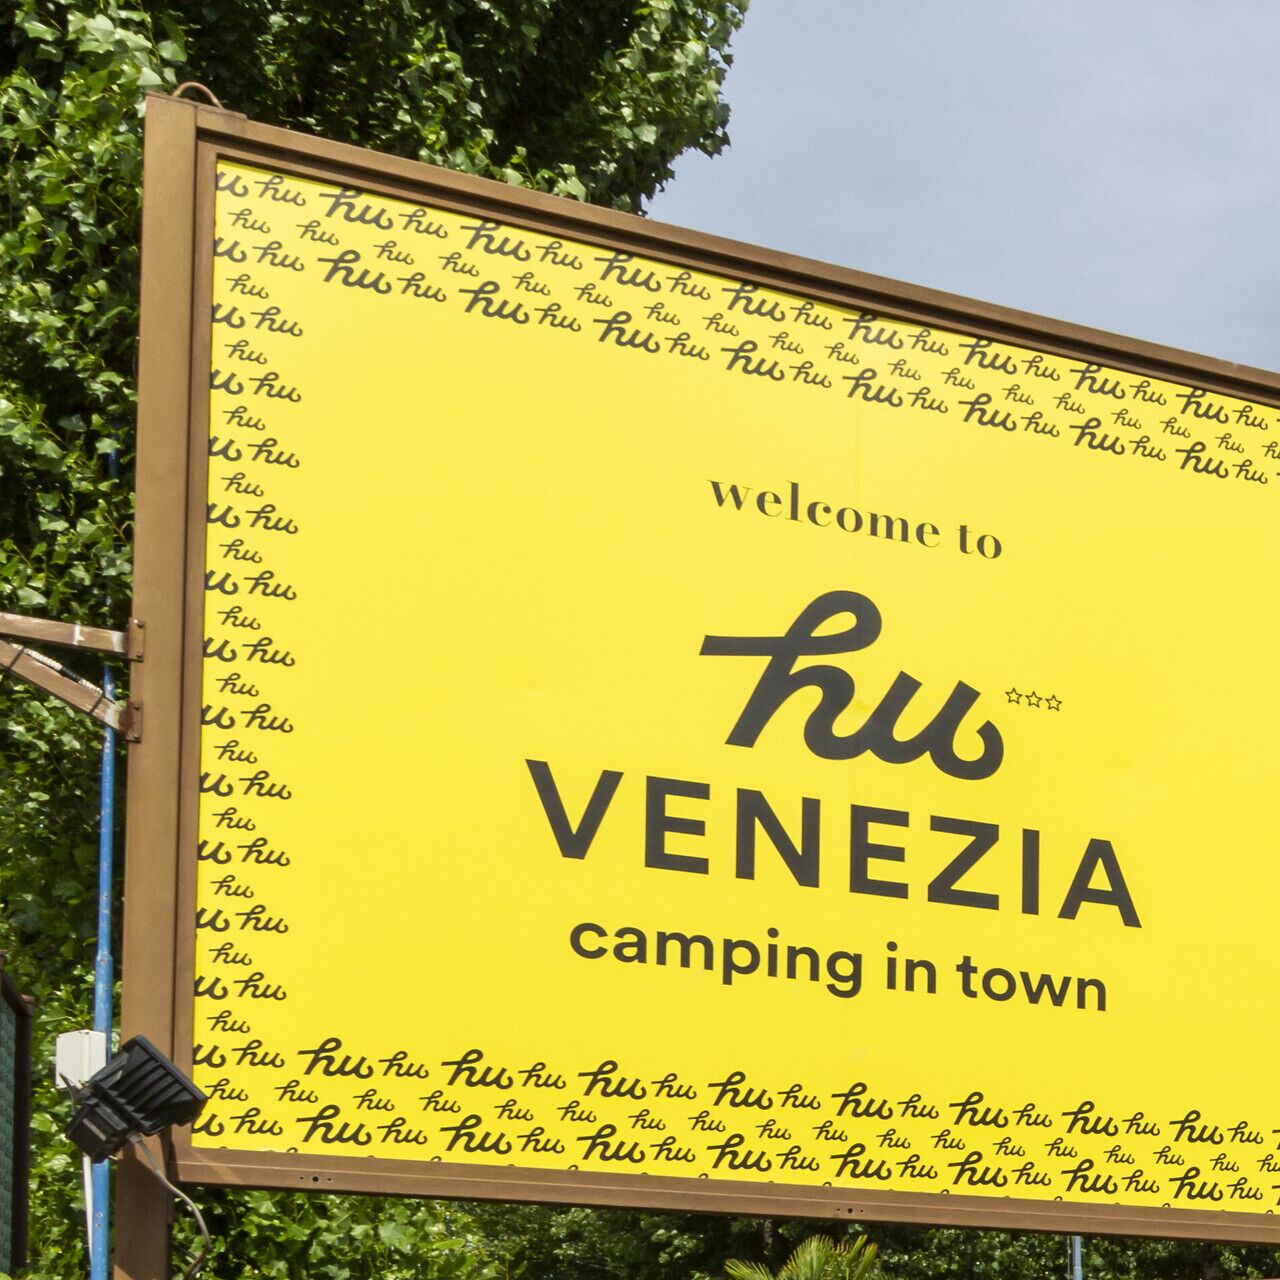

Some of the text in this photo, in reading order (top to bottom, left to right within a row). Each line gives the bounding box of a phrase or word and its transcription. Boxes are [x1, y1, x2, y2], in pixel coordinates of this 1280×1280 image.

[251, 307, 302, 336] hu
[255, 176, 306, 206] hu
[319, 190, 393, 230] hu
[399, 210, 448, 238] hu
[461, 223, 531, 261] hu
[536, 241, 582, 270] hu
[595, 254, 661, 292] hu
[666, 272, 710, 300] hu
[722, 284, 785, 322] hu
[790, 301, 832, 330] hu
[843, 308, 903, 349] hu
[908, 328, 948, 356] hu
[959, 339, 1017, 375] hu
[1021, 355, 1060, 381] hu
[1070, 364, 1125, 399] hu
[1129, 380, 1166, 405] hu
[1176, 389, 1229, 424] hu
[1233, 404, 1268, 430] hu
[374, 241, 414, 265] hu
[703, 313, 739, 336] hu
[1053, 393, 1085, 414] hu
[253, 241, 304, 271] hu
[318, 250, 392, 294] hu
[397, 272, 446, 302] hu
[459, 281, 529, 324] hu
[534, 303, 581, 332] hu
[593, 311, 660, 353] hu
[665, 332, 709, 360] hu
[721, 340, 785, 381] hu
[790, 361, 831, 388] hu
[843, 368, 903, 407] hu
[907, 387, 948, 413] hu
[958, 393, 1017, 431] hu
[1021, 412, 1059, 437] hu
[1070, 418, 1125, 455] hu
[1129, 436, 1166, 461] hu
[1176, 441, 1229, 478] hu
[1232, 459, 1267, 484] hu
[248, 438, 299, 468] hu
[707, 479, 1003, 559] welcome to
[244, 570, 296, 600] hu
[241, 704, 293, 733] hu
[698, 590, 1005, 781] hu
[237, 837, 290, 866] hu
[525, 758, 1143, 929] VENEZIA
[234, 972, 286, 1000] hu
[569, 921, 1107, 1012] camping in town
[232, 1039, 285, 1068] hu
[298, 1037, 374, 1079] hu
[379, 1051, 429, 1079] hu
[441, 1049, 513, 1090] hu
[518, 1062, 566, 1089] hu
[578, 1060, 647, 1100] hu
[651, 1073, 697, 1099] hu
[708, 1071, 773, 1110] hu
[777, 1084, 821, 1110] hu
[831, 1082, 893, 1120] hu
[897, 1094, 939, 1119] hu
[949, 1091, 1008, 1128] hu
[1012, 1103, 1052, 1127] hu
[1061, 1101, 1119, 1136] hu
[1122, 1112, 1160, 1136] hu
[1169, 1110, 1224, 1145] hu
[1227, 1121, 1263, 1144] hu
[353, 1089, 1184, 1165] hu hu hu hu
[230, 1107, 283, 1136] hu
[296, 1105, 372, 1146] hu
[377, 1117, 427, 1145] hu
[440, 1114, 512, 1154] hu
[517, 1127, 565, 1154] hu
[577, 1124, 645, 1163] hu
[650, 1136, 695, 1162] hu
[707, 1133, 772, 1172] hu
[776, 1145, 819, 1171] hu
[830, 1143, 892, 1180] hu
[896, 1154, 938, 1179] hu
[948, 1151, 1008, 1187] hu
[1012, 1162, 1051, 1186] hu
[1061, 1159, 1118, 1194] hu
[1122, 1169, 1160, 1193] hu
[1169, 1167, 1223, 1201] hu
[1227, 1177, 1263, 1200] hu
